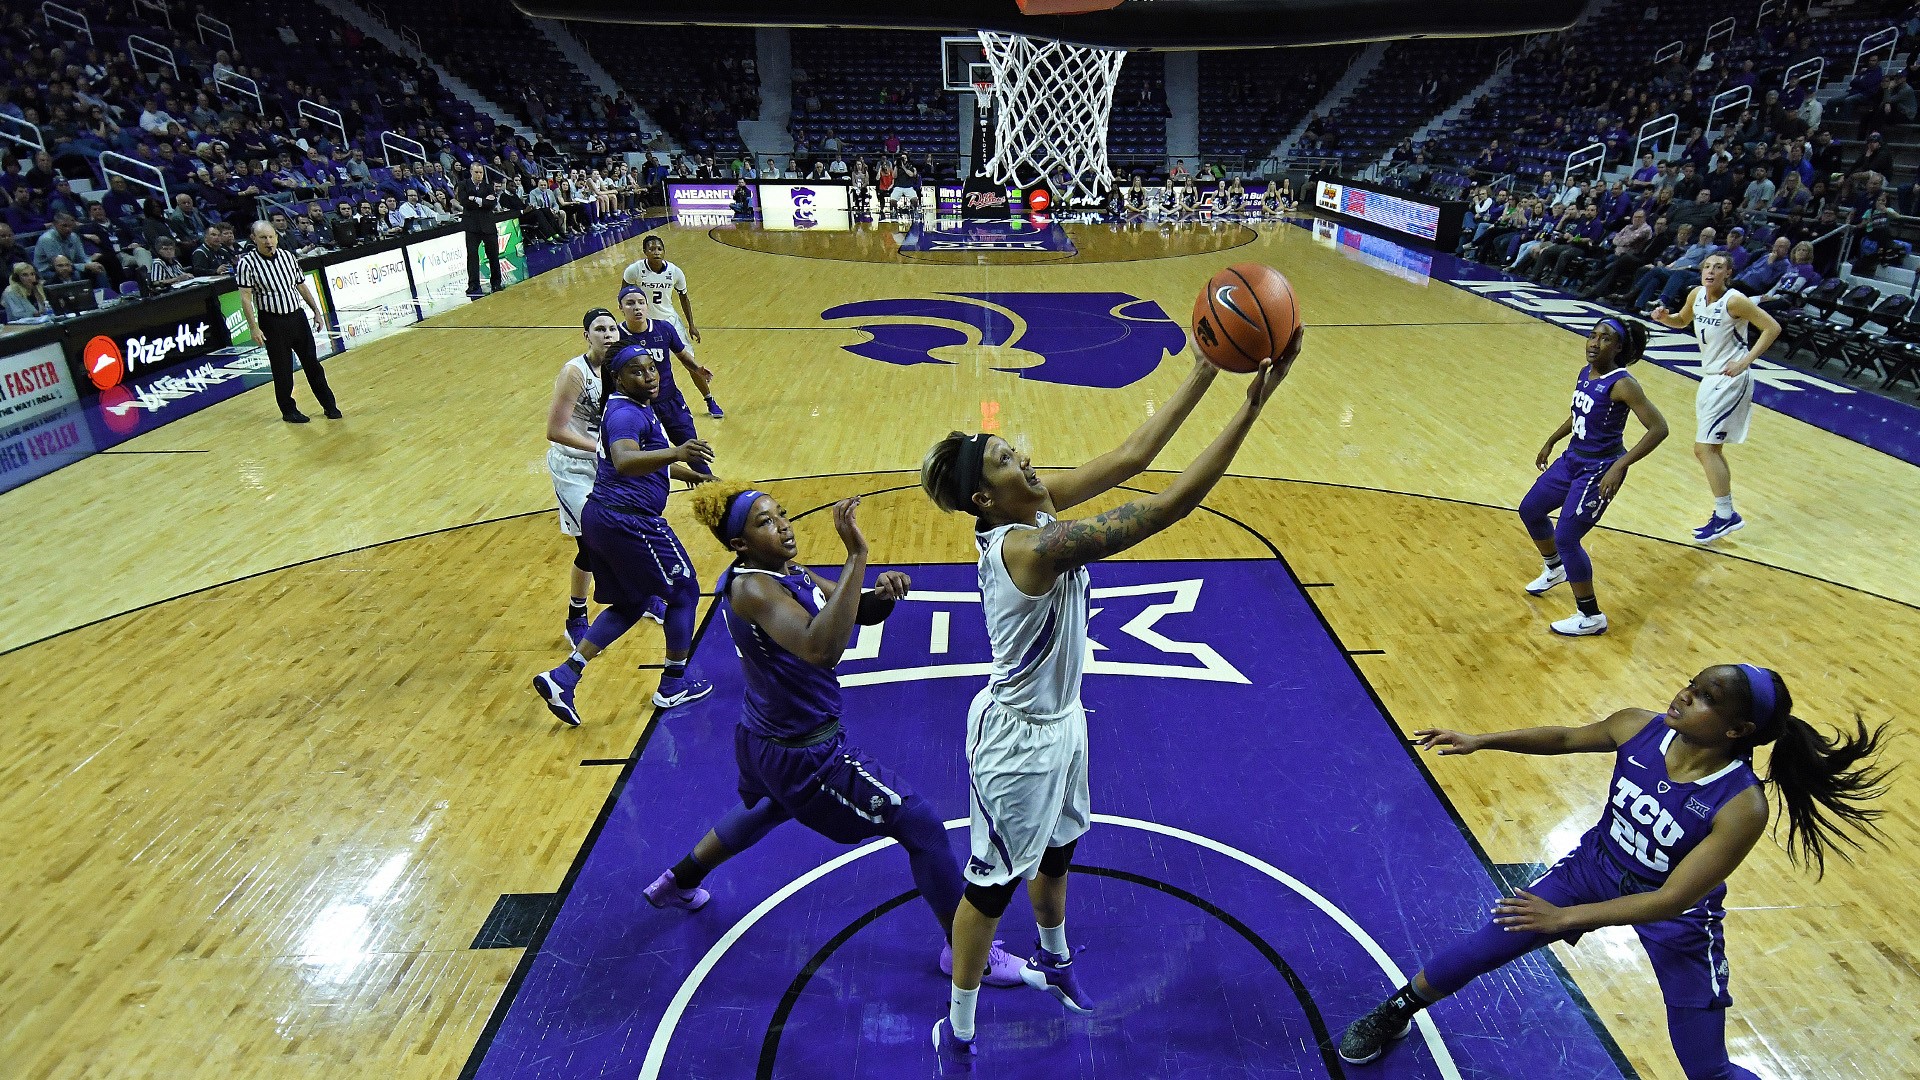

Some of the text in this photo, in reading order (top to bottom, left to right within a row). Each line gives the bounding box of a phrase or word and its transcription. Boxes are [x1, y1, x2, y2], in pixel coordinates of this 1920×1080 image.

[674, 189, 753, 199] AHEARNFU
[641, 281, 672, 289] K-STATE
[652, 290, 663, 304] 2
[1700, 328, 1708, 345] 1
[126, 322, 209, 372] Pizza Hut
[5, 361, 59, 398] FASTER
[14, 400, 31, 411] WAY
[1612, 776, 1685, 847] TCU
